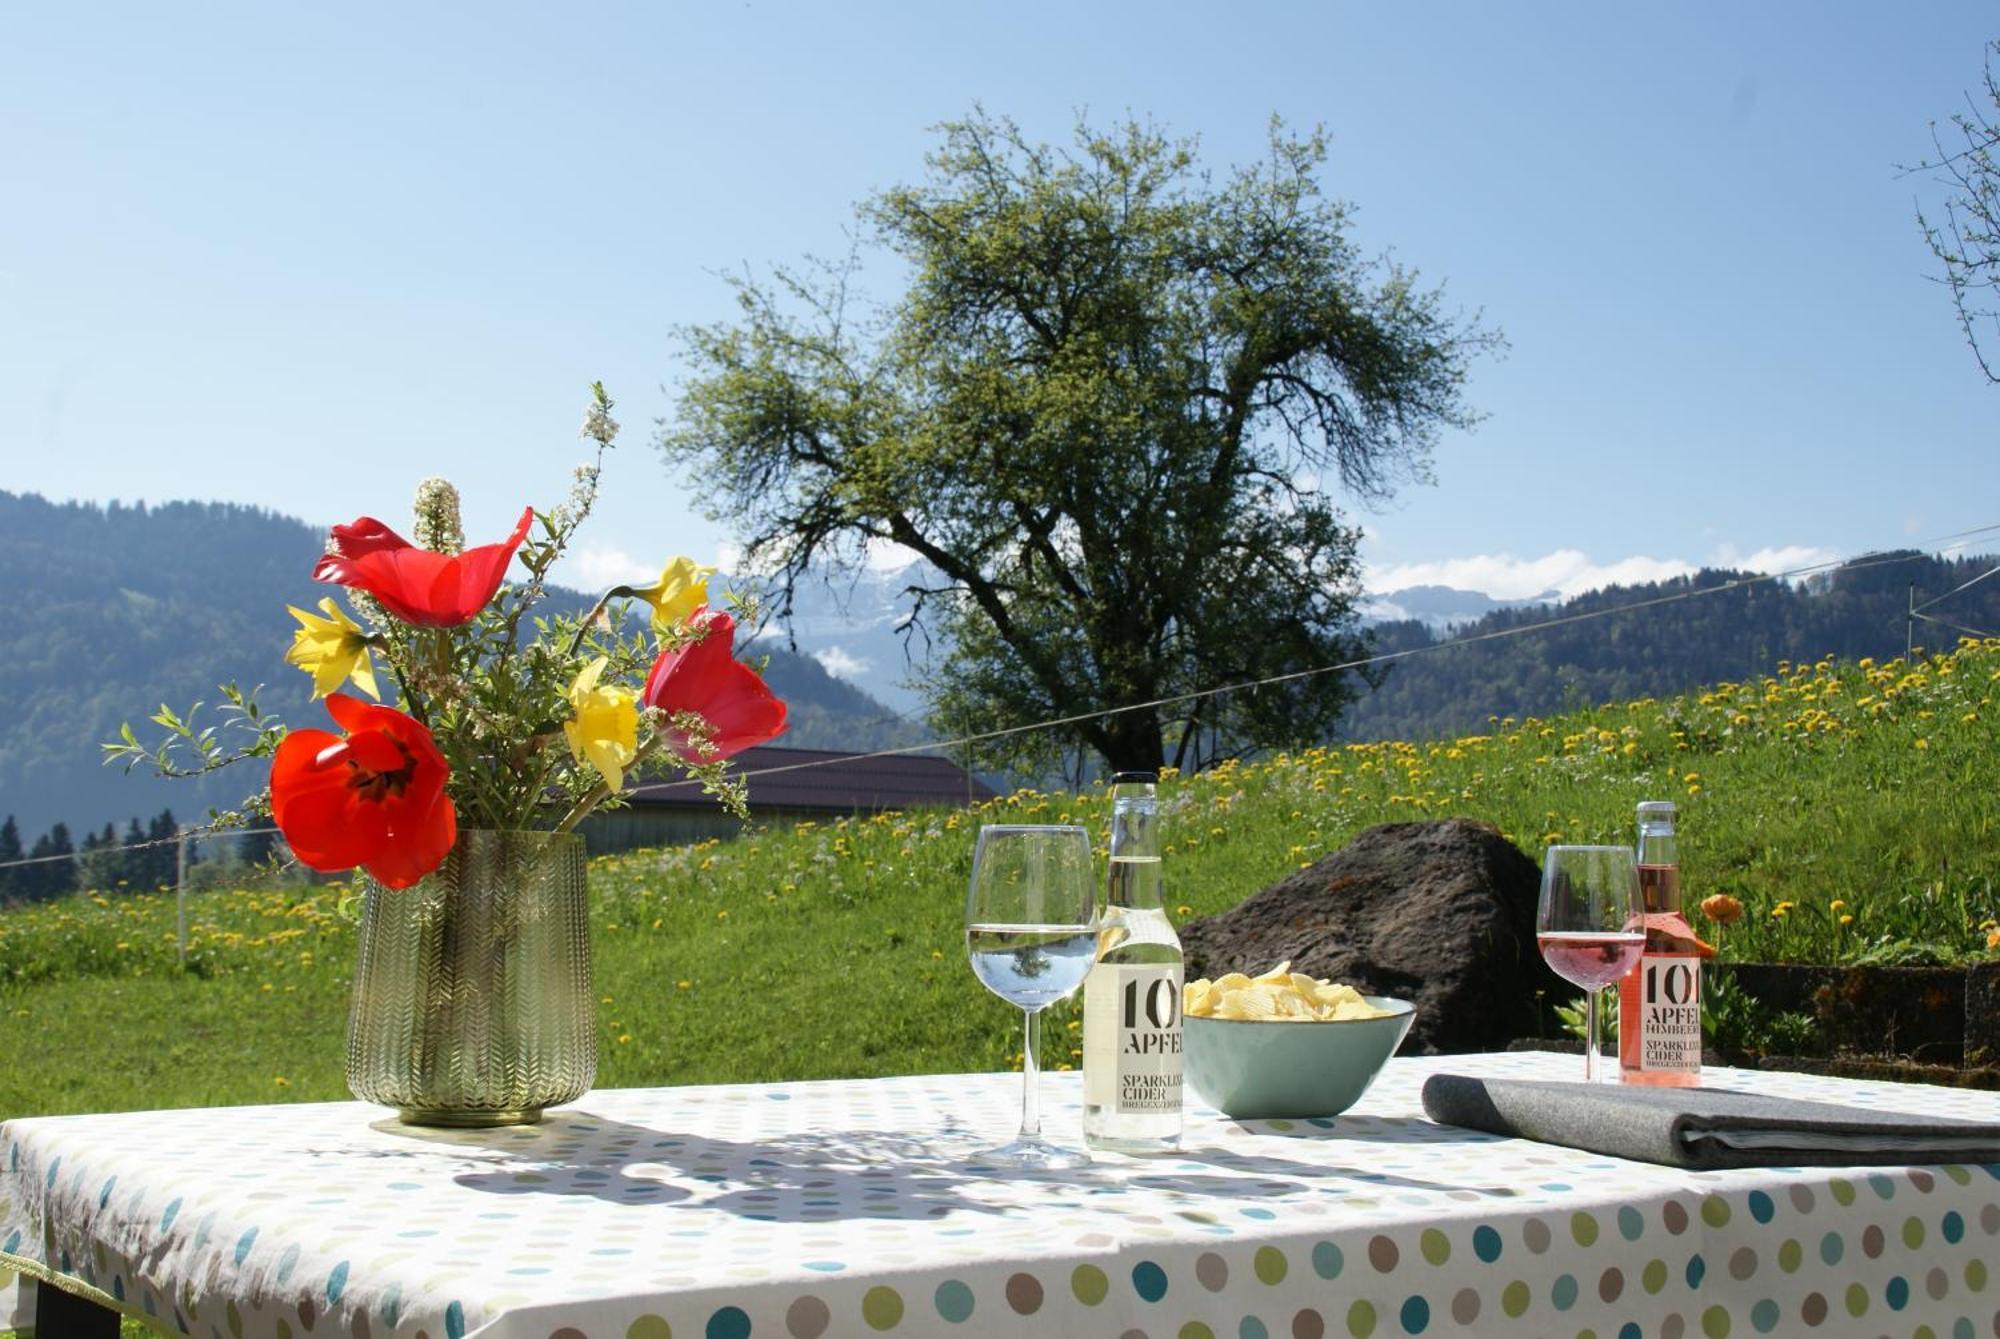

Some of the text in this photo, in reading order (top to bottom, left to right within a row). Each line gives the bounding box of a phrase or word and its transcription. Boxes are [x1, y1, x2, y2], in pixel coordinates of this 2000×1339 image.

[1647, 964, 1699, 1004] 101
[1646, 1050, 1682, 1060] CIDER
[1123, 1087, 1165, 1100] CIDER
